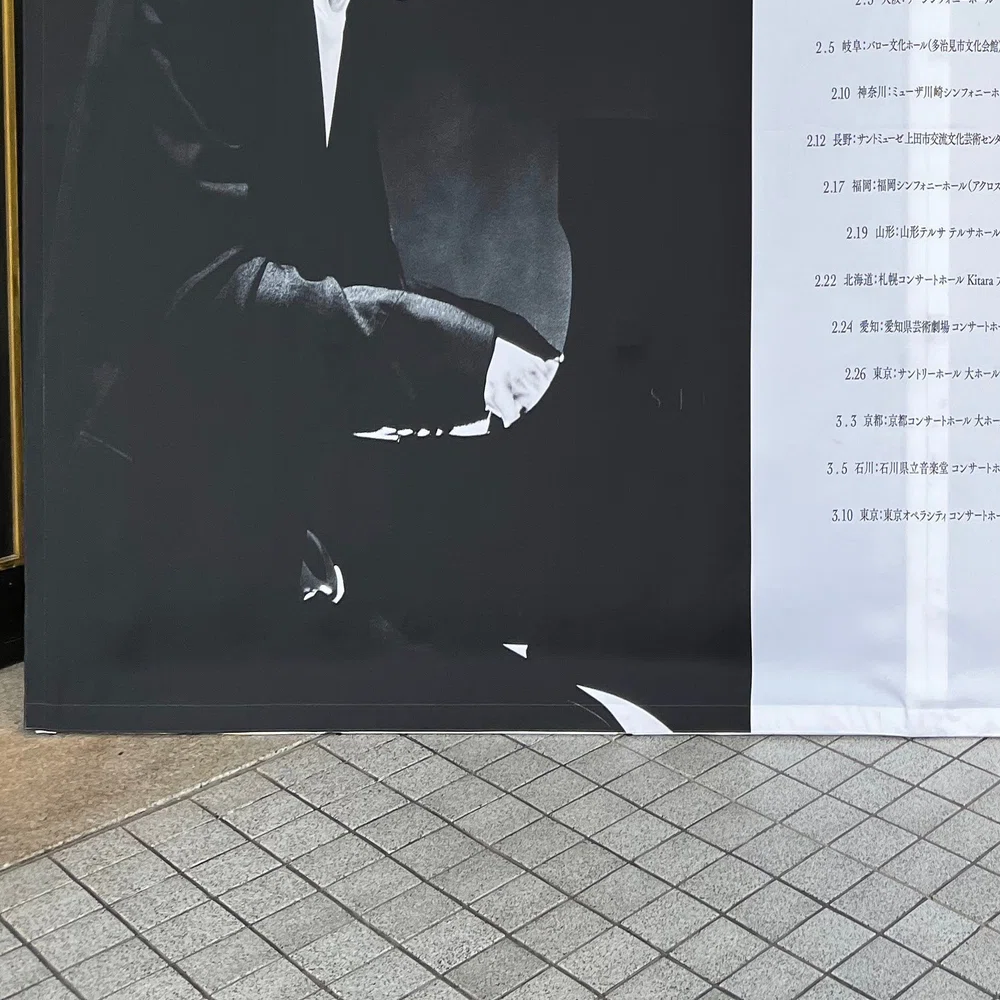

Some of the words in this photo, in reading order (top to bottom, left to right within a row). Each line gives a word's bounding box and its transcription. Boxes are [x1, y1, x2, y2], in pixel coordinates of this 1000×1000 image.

[831, 86, 850, 101] 2.10
[807, 133, 826, 148] 2.12
[823, 180, 845, 194] 2.17
[847, 225, 868, 240] 2.19
[815, 273, 836, 288] 2.22
[967, 273, 993, 286] Kitara
[832, 319, 853, 334] 2.24
[845, 366, 866, 381] 2.26
[964, 366, 1000, 381] 大ホール
[832, 508, 853, 522] 3.10
